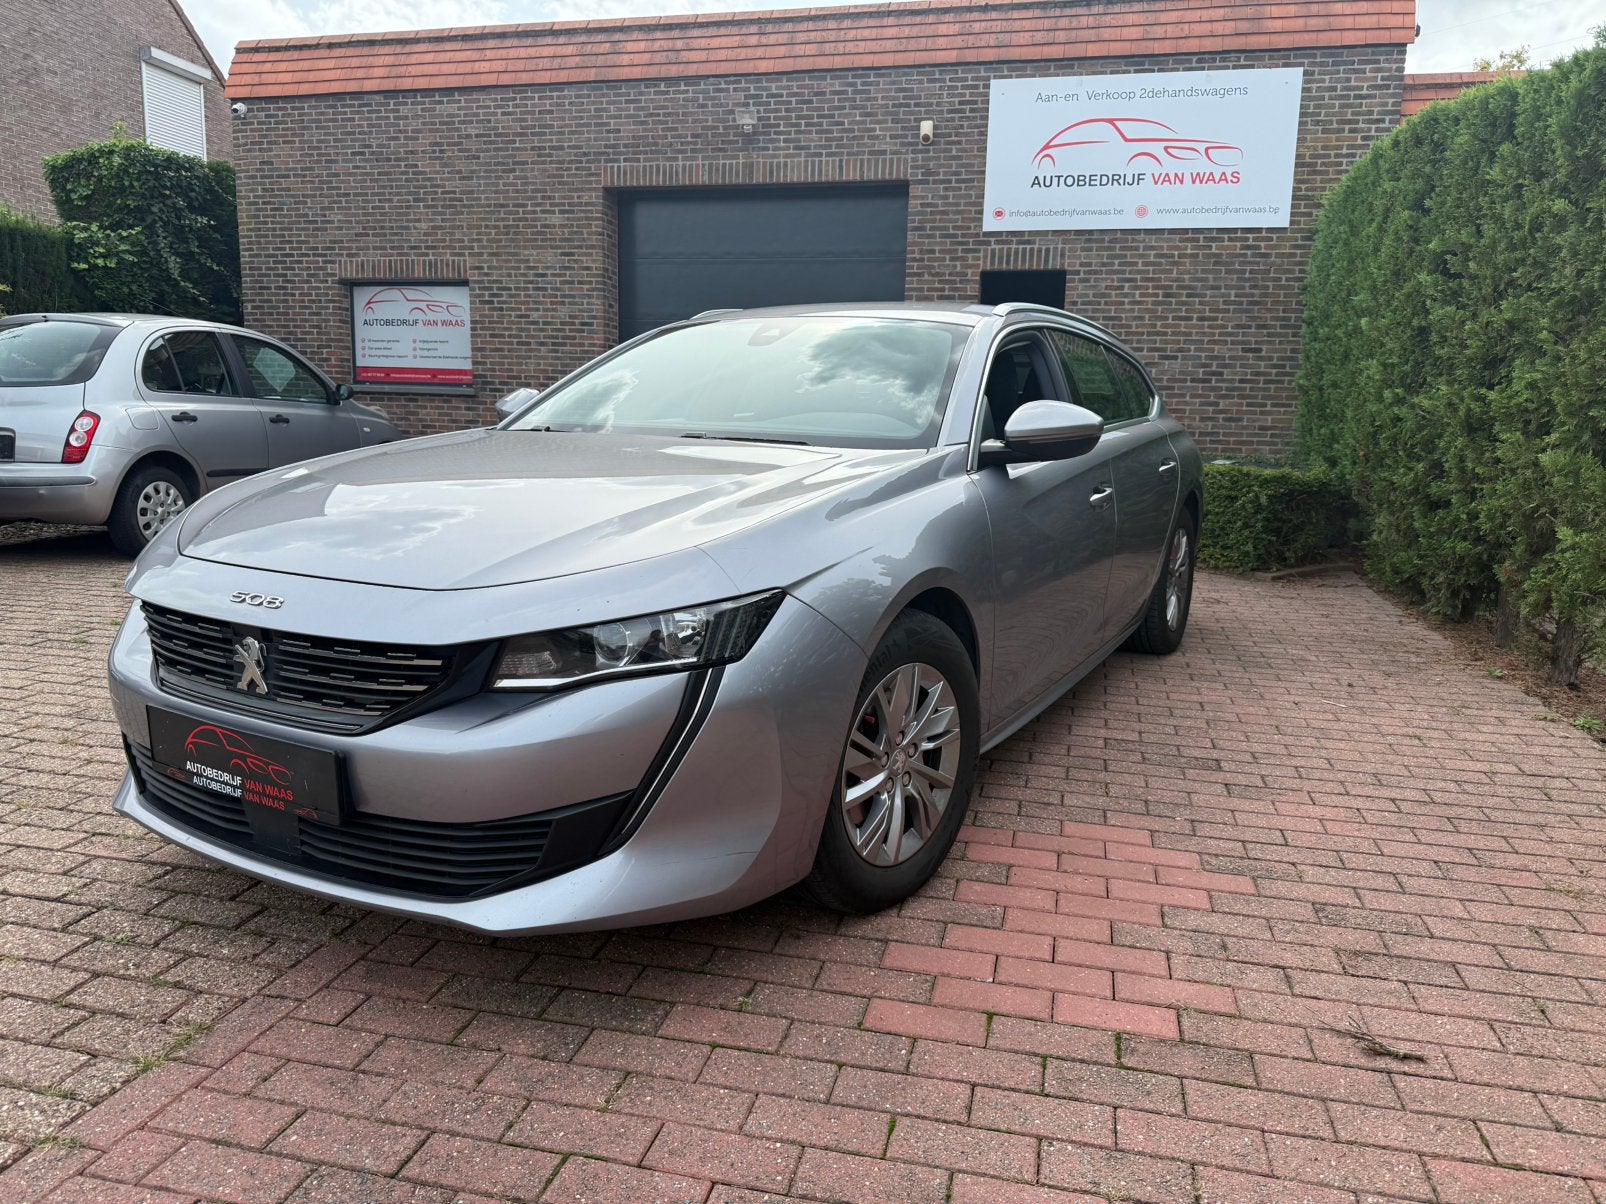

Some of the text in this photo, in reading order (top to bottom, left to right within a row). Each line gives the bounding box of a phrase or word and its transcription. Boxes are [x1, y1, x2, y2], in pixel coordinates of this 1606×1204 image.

[1035, 86, 1249, 103] Aan-en Verkoop 2dehandswagens
[1030, 171, 1241, 189] AUTOBEDRIJF VAN WAAS
[1009, 207, 1125, 218] info@autobedrijfvanwaas.be
[1156, 205, 1280, 215] www.autobedrijfvanwaas.be
[362, 318, 466, 328] AUTOBEDRIJF VAN WAAS
[230, 590, 285, 609] 508
[186, 760, 294, 801] AUTOBEDRIJF VAN WAAS
[193, 775, 285, 811] AUTOBEDRIJF VAN WAAS
